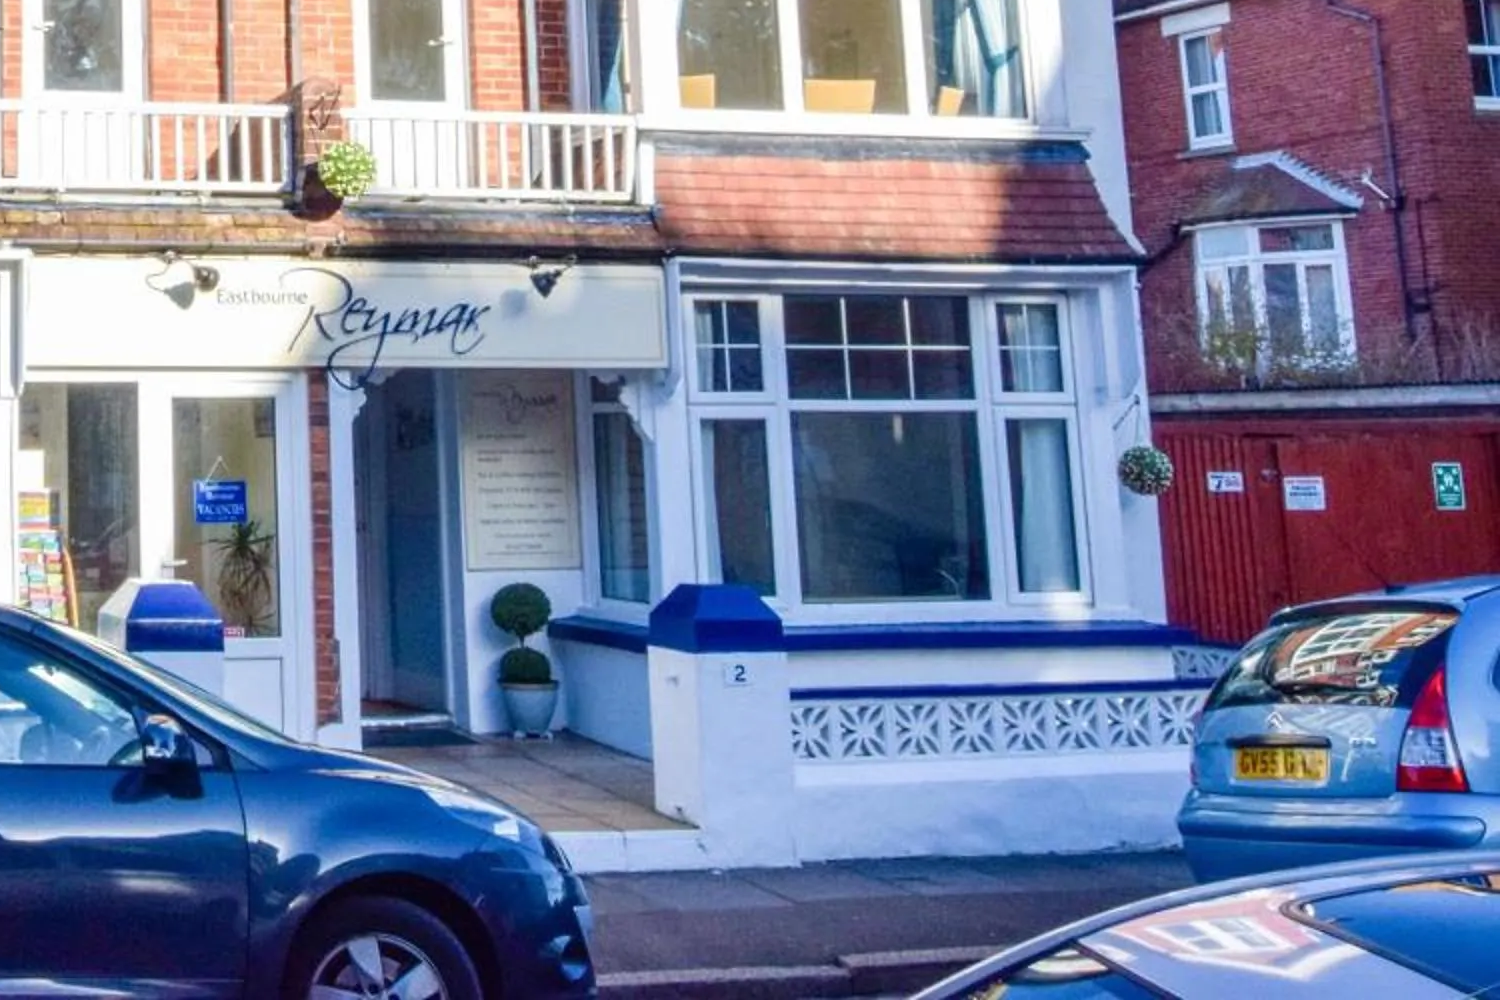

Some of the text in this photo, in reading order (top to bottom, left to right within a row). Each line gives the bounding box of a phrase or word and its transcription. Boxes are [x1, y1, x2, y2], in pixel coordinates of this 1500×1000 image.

[217, 267, 491, 390] Eastbourne Reymar
[733, 664, 747, 682] 2
